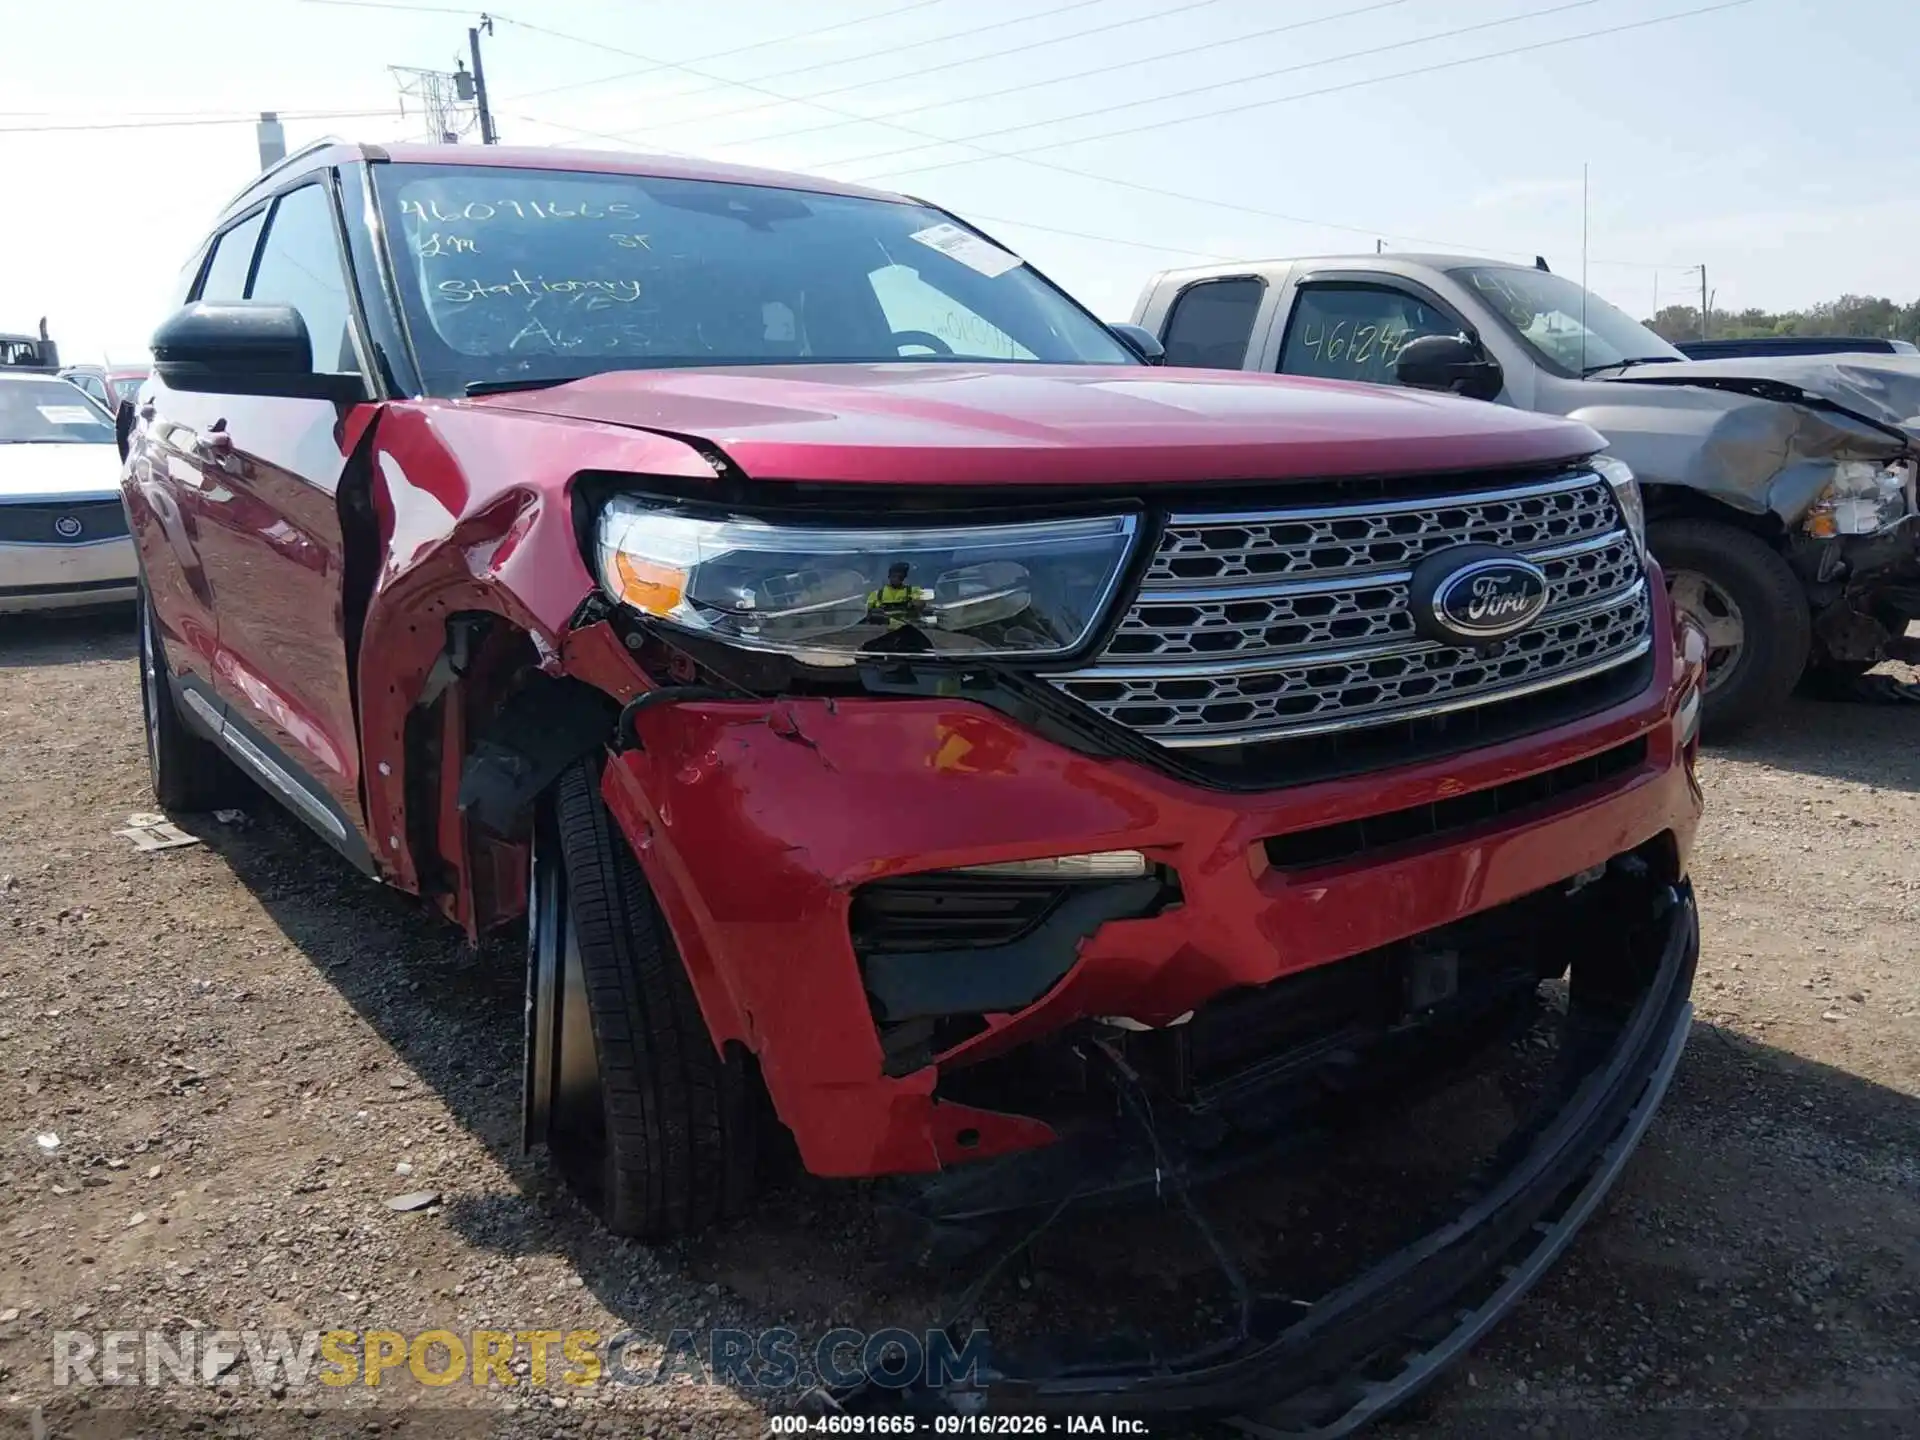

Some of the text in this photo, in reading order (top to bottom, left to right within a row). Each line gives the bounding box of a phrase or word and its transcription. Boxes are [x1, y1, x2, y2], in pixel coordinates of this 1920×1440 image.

[400, 199, 640, 222] 46091665
[438, 269, 641, 302] Stationary
[1468, 576, 1528, 620] Ford
